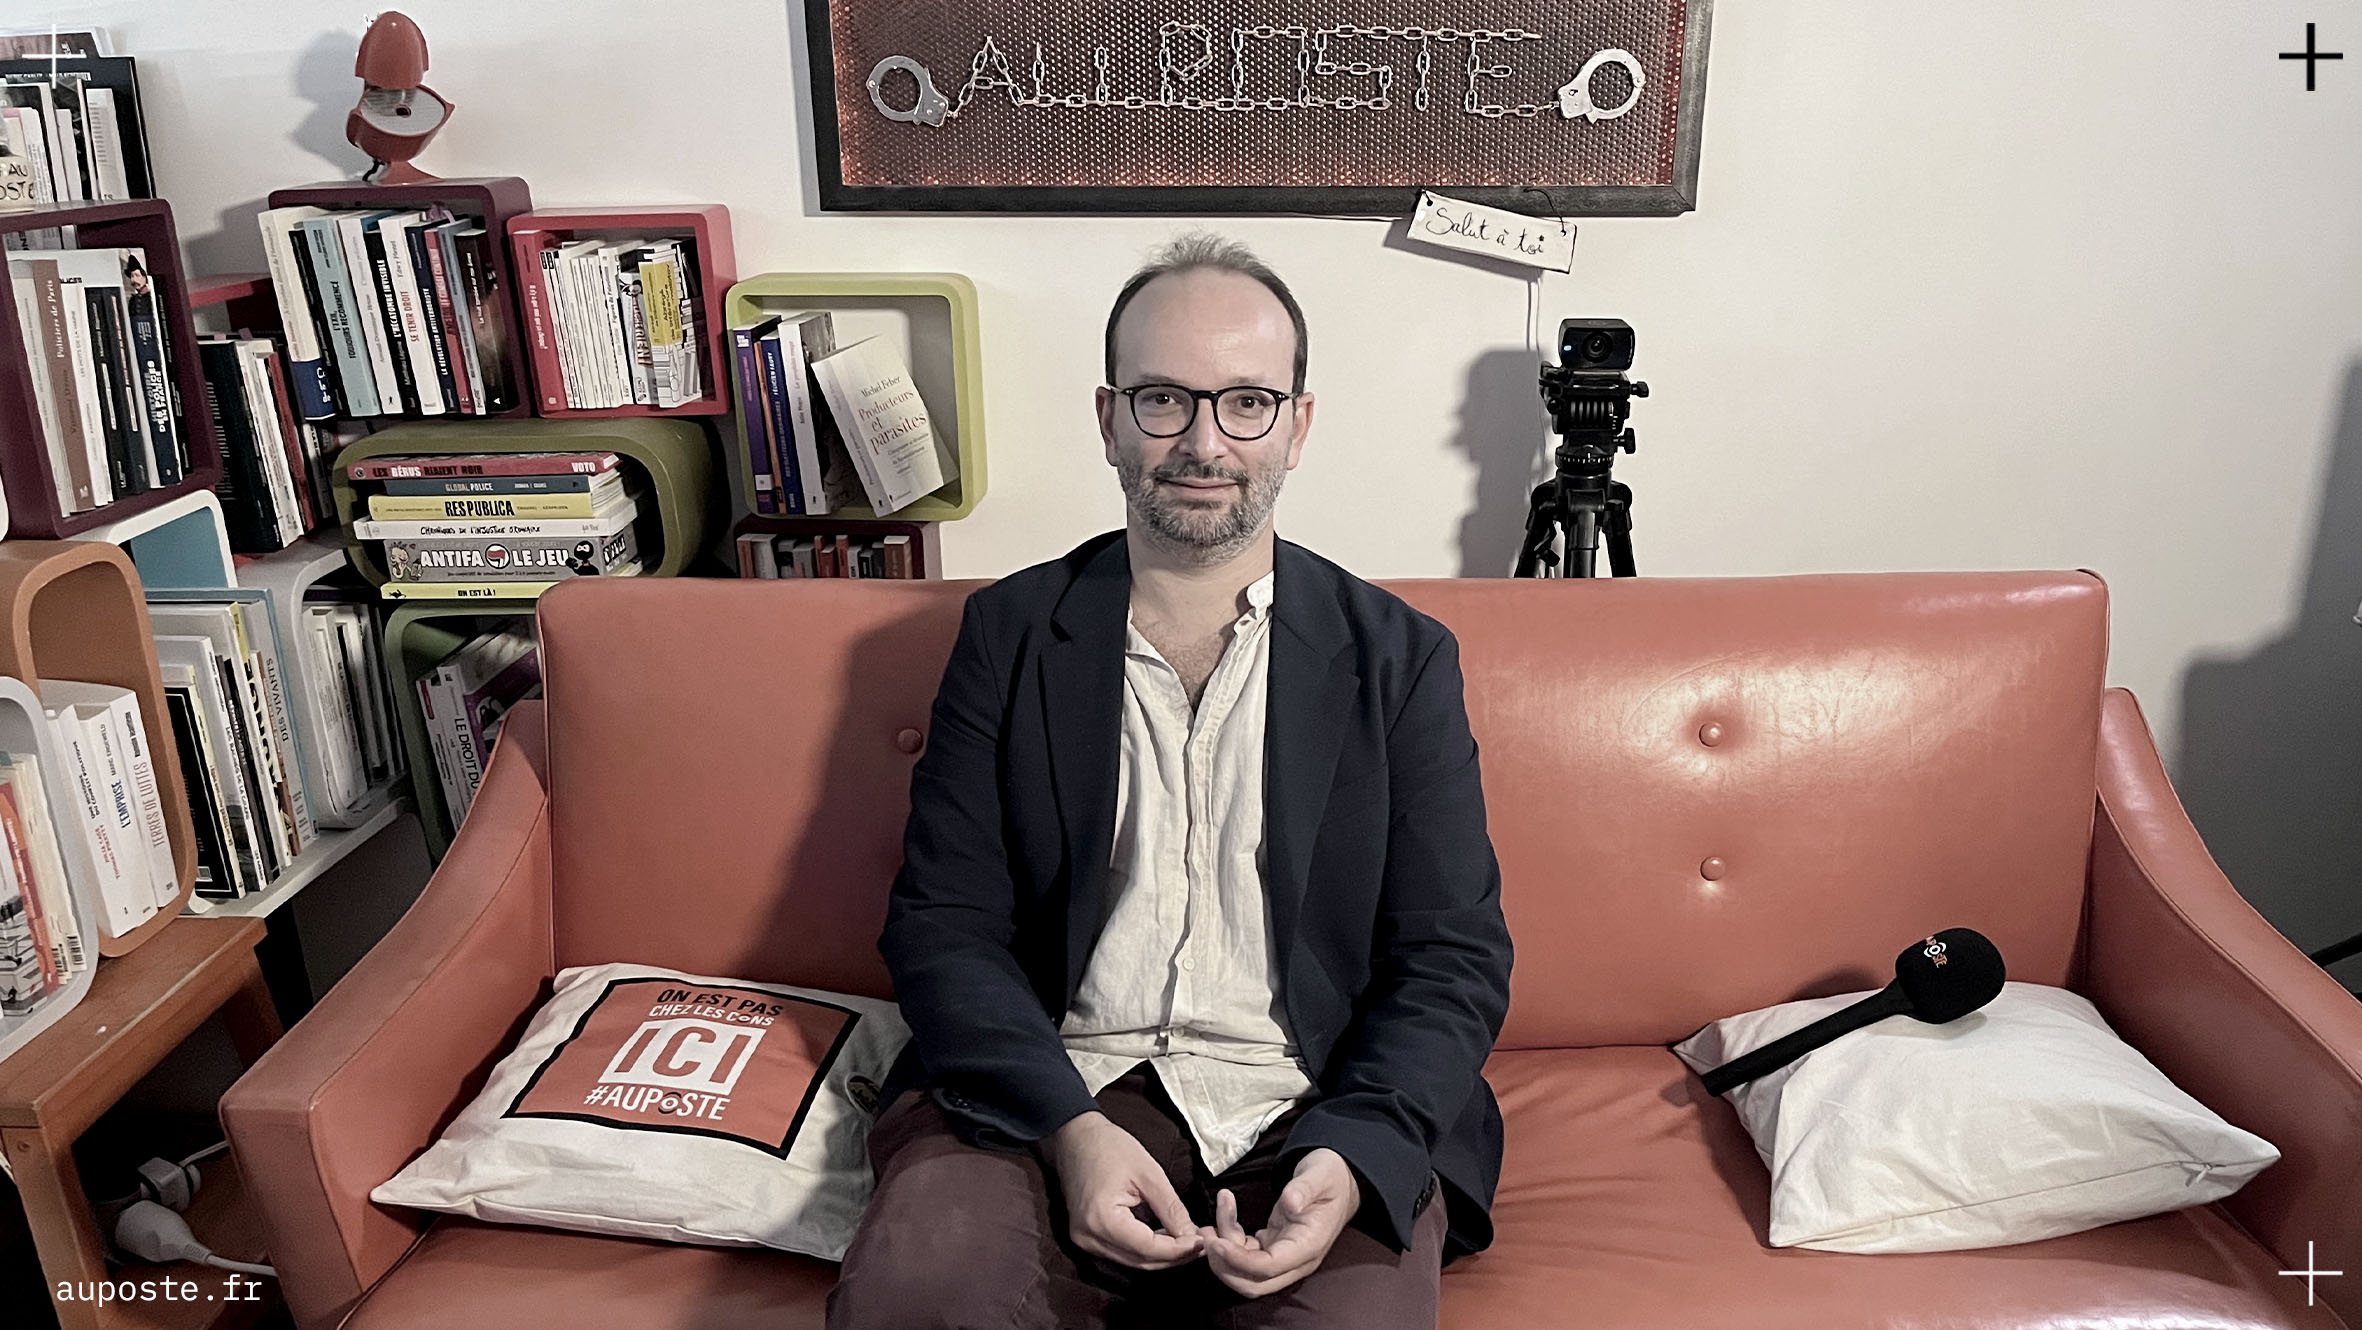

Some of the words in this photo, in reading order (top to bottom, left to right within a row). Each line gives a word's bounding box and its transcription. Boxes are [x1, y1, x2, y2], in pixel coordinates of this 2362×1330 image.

[1425, 207, 1491, 240] Salut
[1496, 229, 1509, 246] à
[1513, 228, 1545, 255] toi
[376, 259, 391, 292] INVISIBLE
[47, 280, 56, 302] Paris
[399, 291, 412, 311] DROIT
[50, 305, 57, 316] de
[384, 293, 401, 337] L'HÉCATOMBE
[405, 313, 416, 332] TENIR
[54, 318, 64, 357] Policiers
[342, 327, 355, 358] TOUJOURS
[146, 358, 163, 408] POLICES
[153, 369, 167, 408] FRANCE
[860, 383, 883, 398] Michel
[144, 370, 159, 422] HISTOIRE
[858, 391, 914, 421] Producteurs
[154, 409, 165, 432] DES
[871, 417, 883, 433] et
[870, 412, 927, 455] parasites
[372, 468, 388, 477] LES
[391, 465, 422, 477] BÉRUS
[424, 466, 458, 476] RIAIENT
[461, 465, 484, 475] NOIR
[571, 462, 596, 473] VOTO
[445, 483, 470, 491] GLOBAL
[470, 482, 493, 491] POLICE
[445, 501, 465, 516] RES
[467, 500, 515, 516] PUBLICA
[421, 549, 486, 568] ANTIFA
[511, 548, 533, 567] LE
[535, 548, 570, 567] JEU
[469, 589, 481, 597] EST
[266, 658, 281, 714] VIVANTS
[225, 725, 233, 741] LES
[278, 716, 288, 741] DES
[455, 718, 467, 731] LE
[229, 742, 241, 773] RACINES
[458, 734, 477, 771] DROIT
[108, 757, 116, 775] MARC
[236, 772, 244, 784] DE
[133, 762, 153, 796] LUTTES
[239, 784, 246, 795] LA
[468, 772, 481, 789] DU
[111, 780, 130, 828] L'EMPRISE
[142, 798, 156, 810] DE
[146, 811, 164, 847] TERRES
[657, 988, 688, 1005] ON
[696, 992, 731, 1008] EST
[738, 998, 784, 1018] PAS
[649, 1004, 690, 1019] CHEZ
[692, 1005, 723, 1021] LES
[726, 1010, 776, 1027] CONS
[614, 1026, 751, 1085] ICI
[583, 1084, 731, 1122] #AUPOSTE
